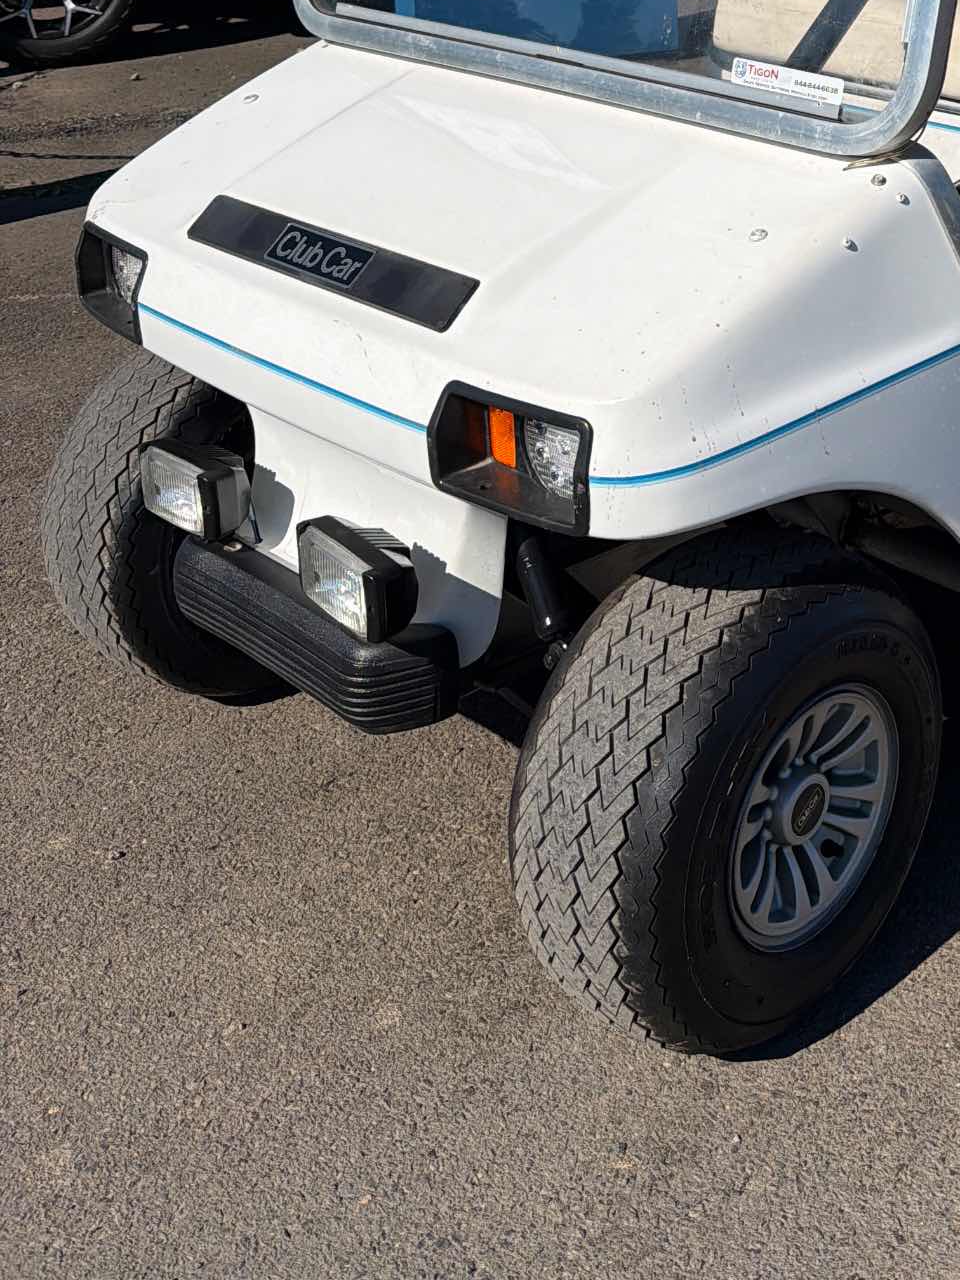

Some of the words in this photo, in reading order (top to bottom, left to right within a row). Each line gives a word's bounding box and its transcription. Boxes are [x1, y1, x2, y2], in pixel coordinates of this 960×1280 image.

[747, 64, 780, 80] TIGON
[275, 230, 323, 269] Club
[320, 246, 362, 281] Car
